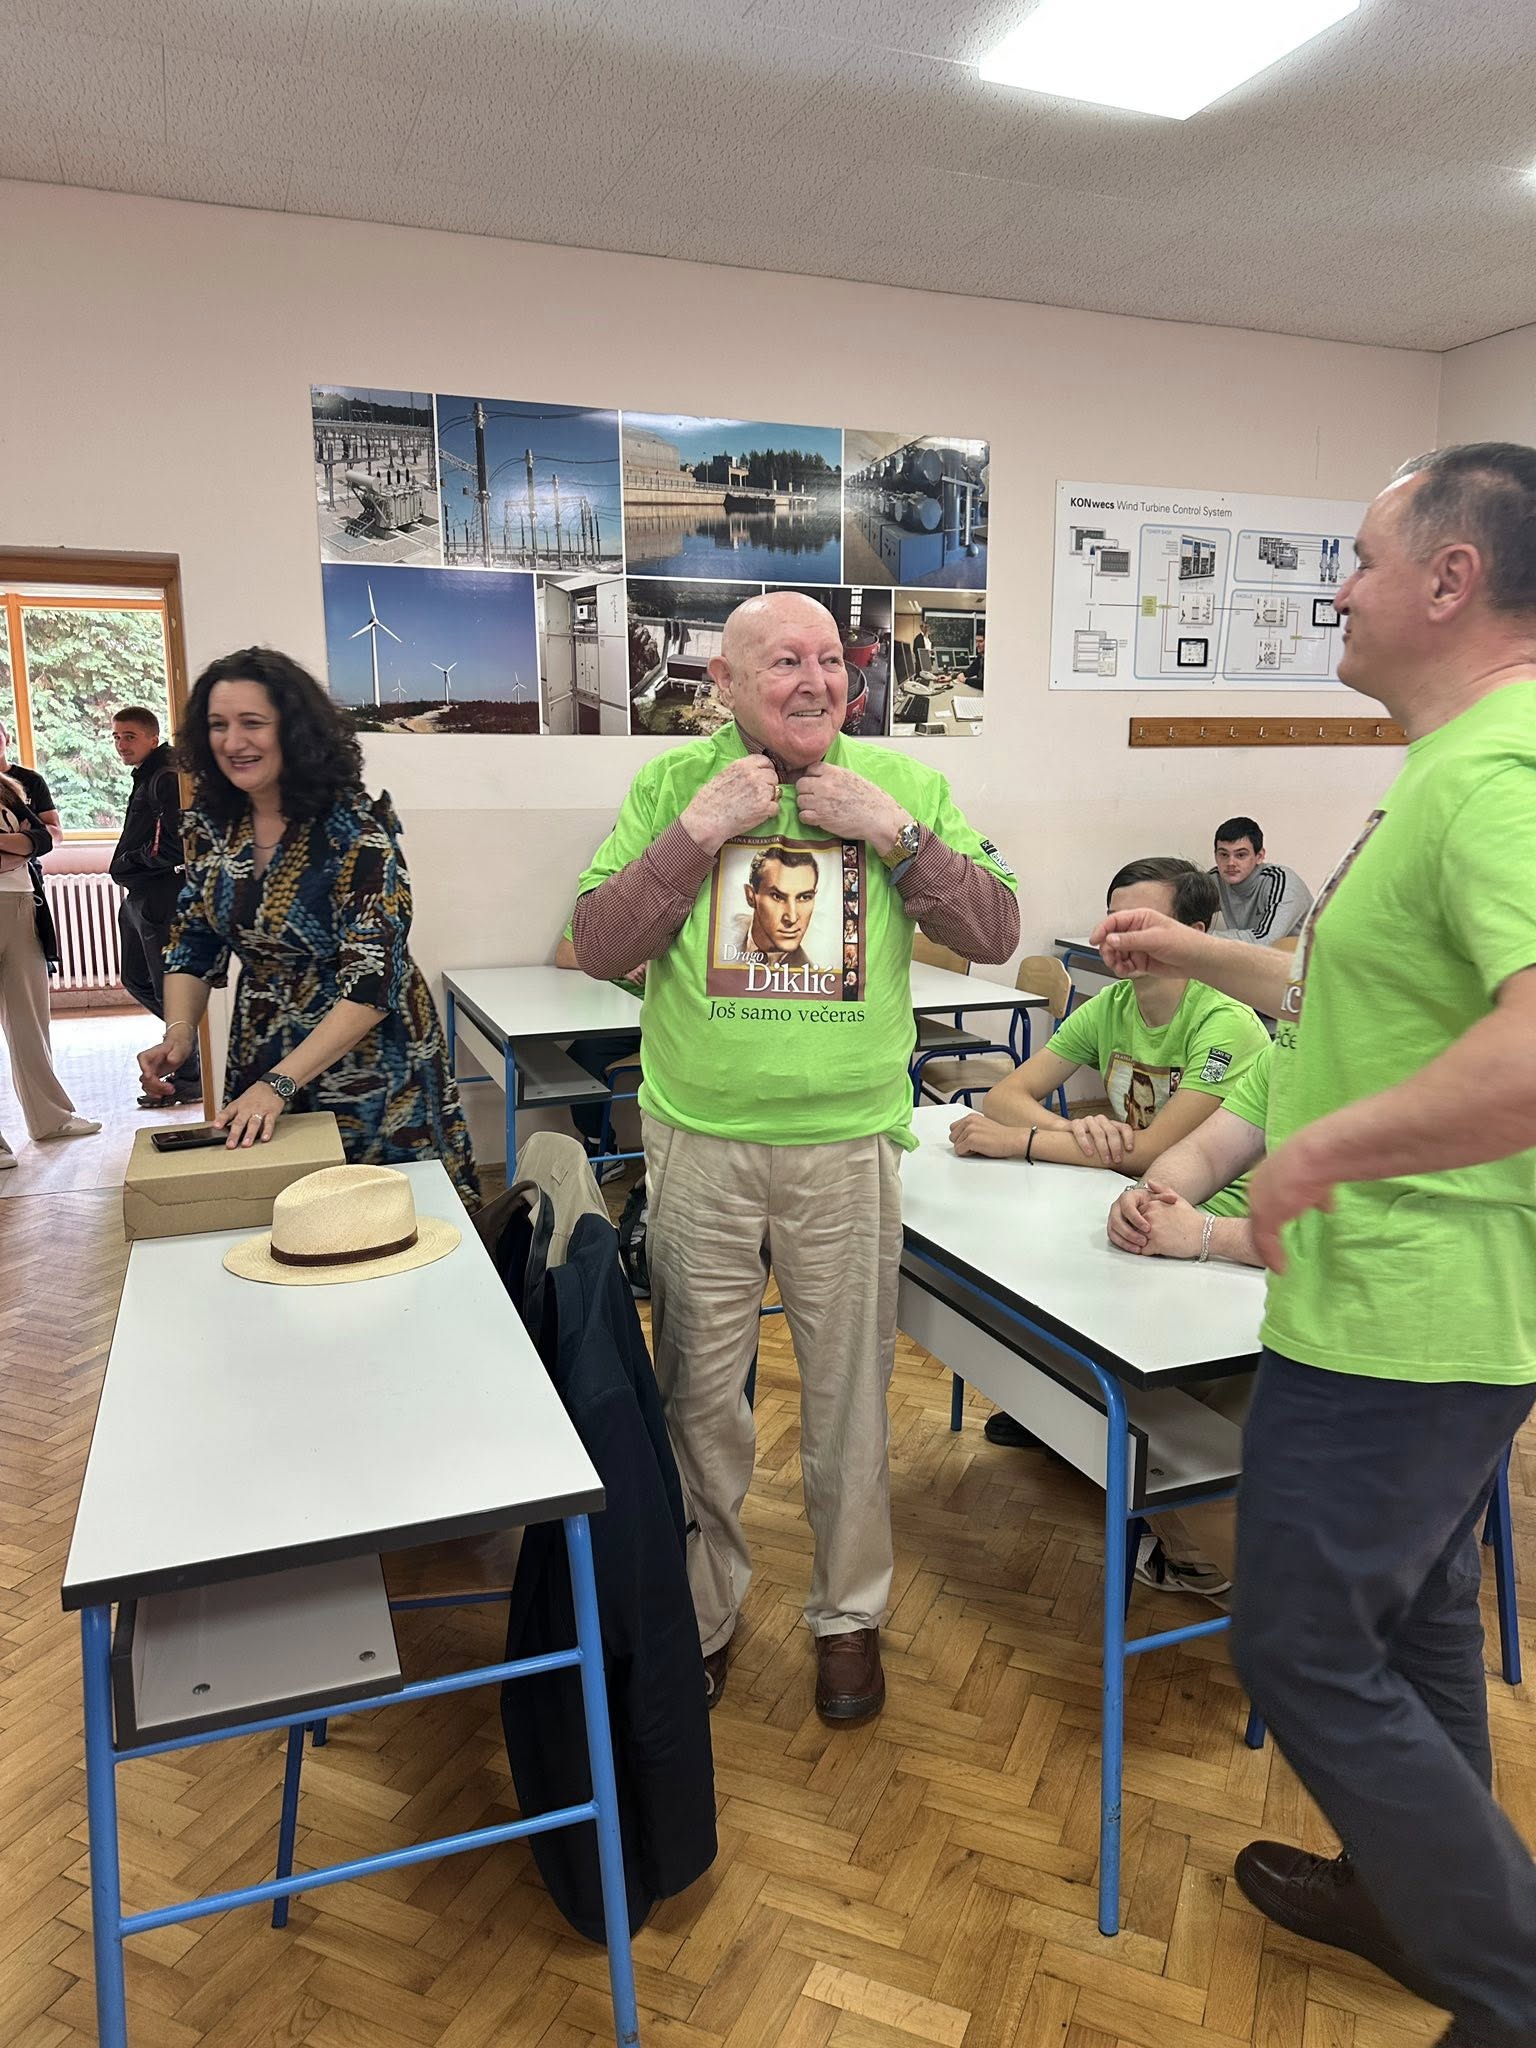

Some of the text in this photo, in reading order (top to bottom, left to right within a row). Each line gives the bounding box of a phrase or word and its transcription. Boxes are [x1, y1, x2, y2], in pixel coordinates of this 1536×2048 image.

[1070, 497, 1232, 518] KONwecs Wind Turbine Control System
[723, 943, 764, 964] Drago
[745, 962, 836, 995] Diklić
[708, 1000, 865, 1023] Još samo večeras
